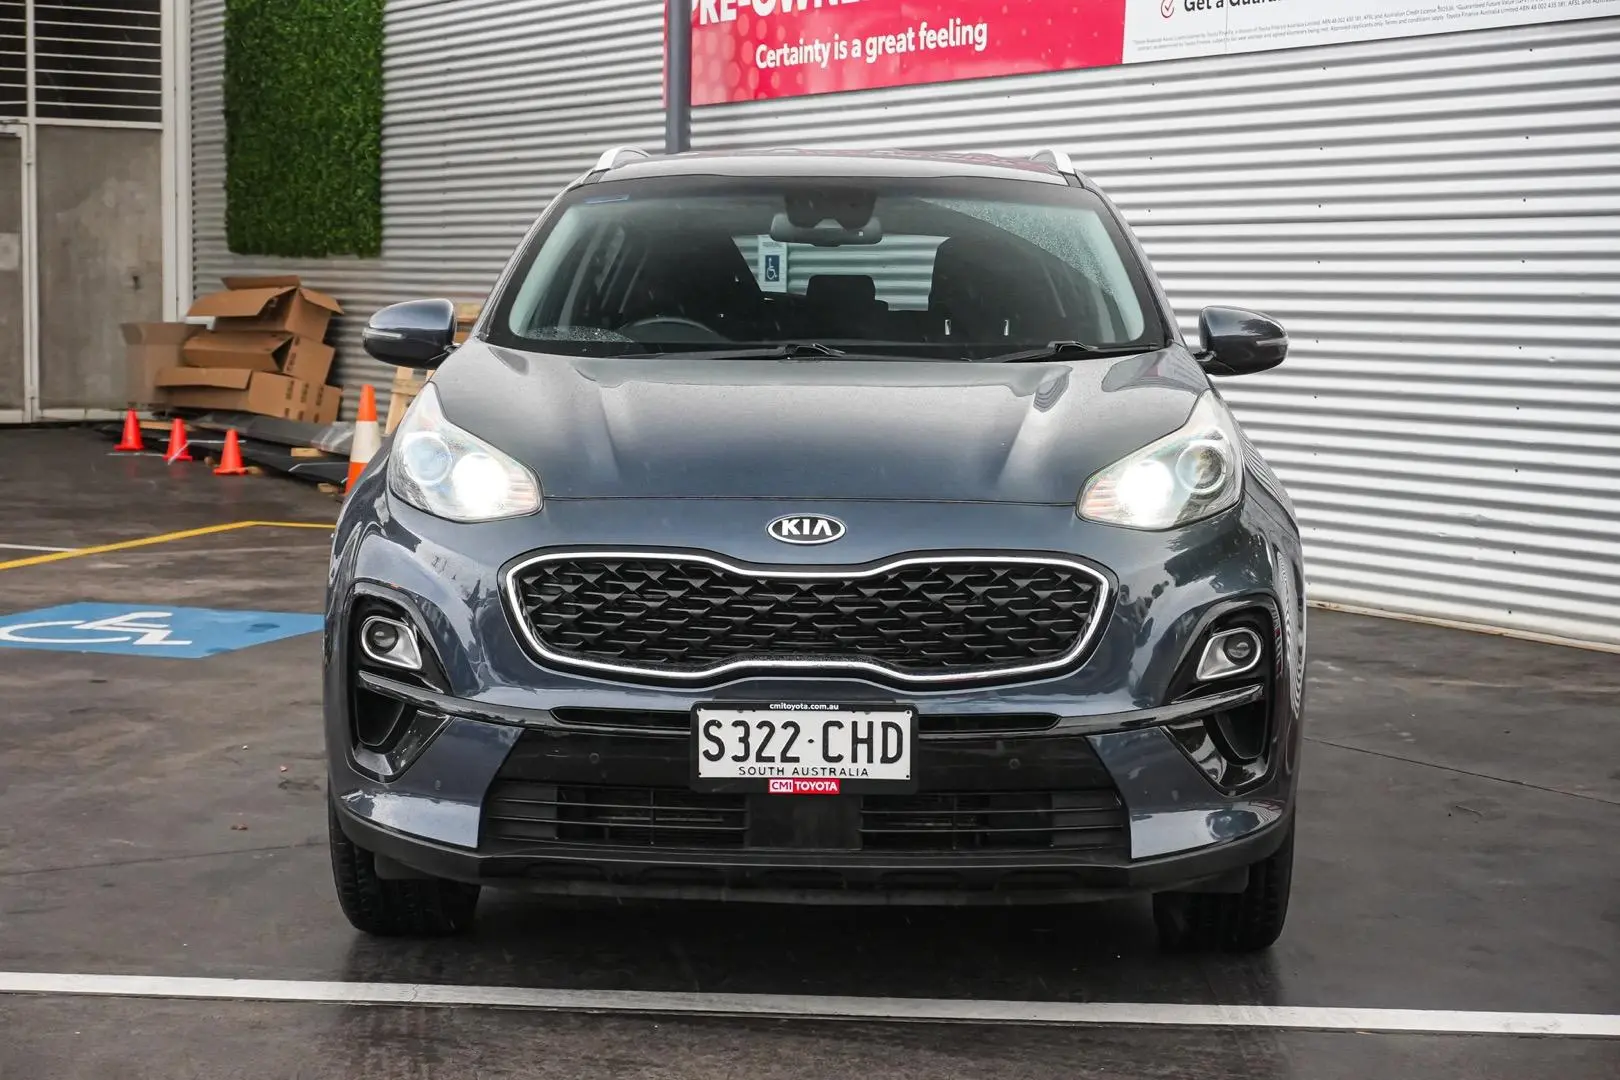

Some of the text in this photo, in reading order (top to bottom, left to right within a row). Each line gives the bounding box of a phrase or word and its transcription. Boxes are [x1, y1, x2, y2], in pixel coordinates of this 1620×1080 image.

[755, 17, 988, 69] Certainty is a great feeling
[781, 518, 833, 536] KIA
[769, 702, 839, 711] cmitoyota.com.au
[738, 766, 869, 777] SOUTH AUSTRALIA
[771, 781, 838, 791] CMI TOYOTA
